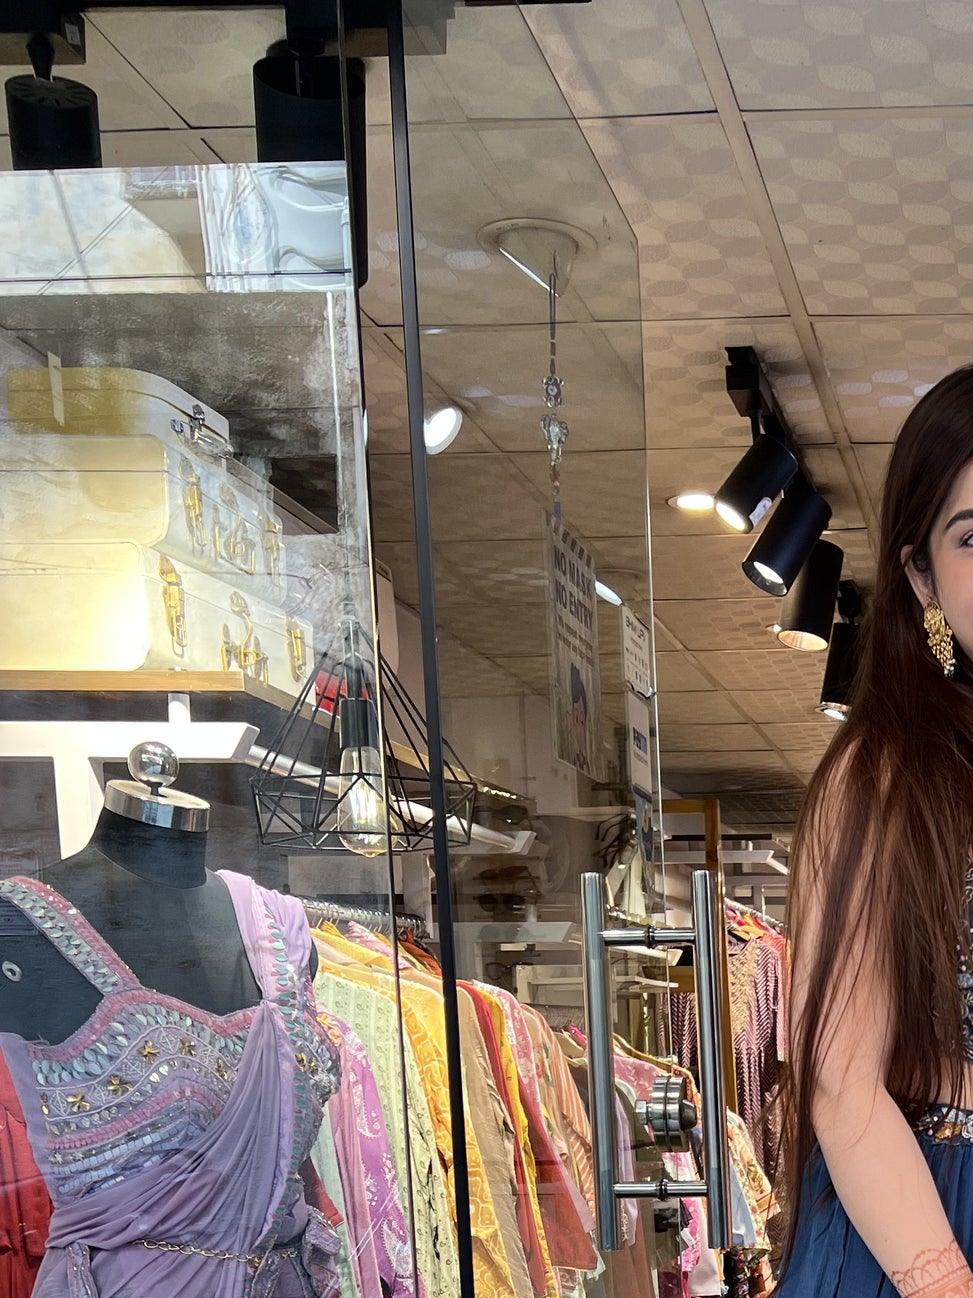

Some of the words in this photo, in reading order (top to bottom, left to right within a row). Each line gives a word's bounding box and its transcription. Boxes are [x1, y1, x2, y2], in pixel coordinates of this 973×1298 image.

[554, 544, 567, 576] NO
[568, 559, 592, 602] MASK
[555, 578, 567, 609] NO
[569, 590, 592, 632] ENTRY
